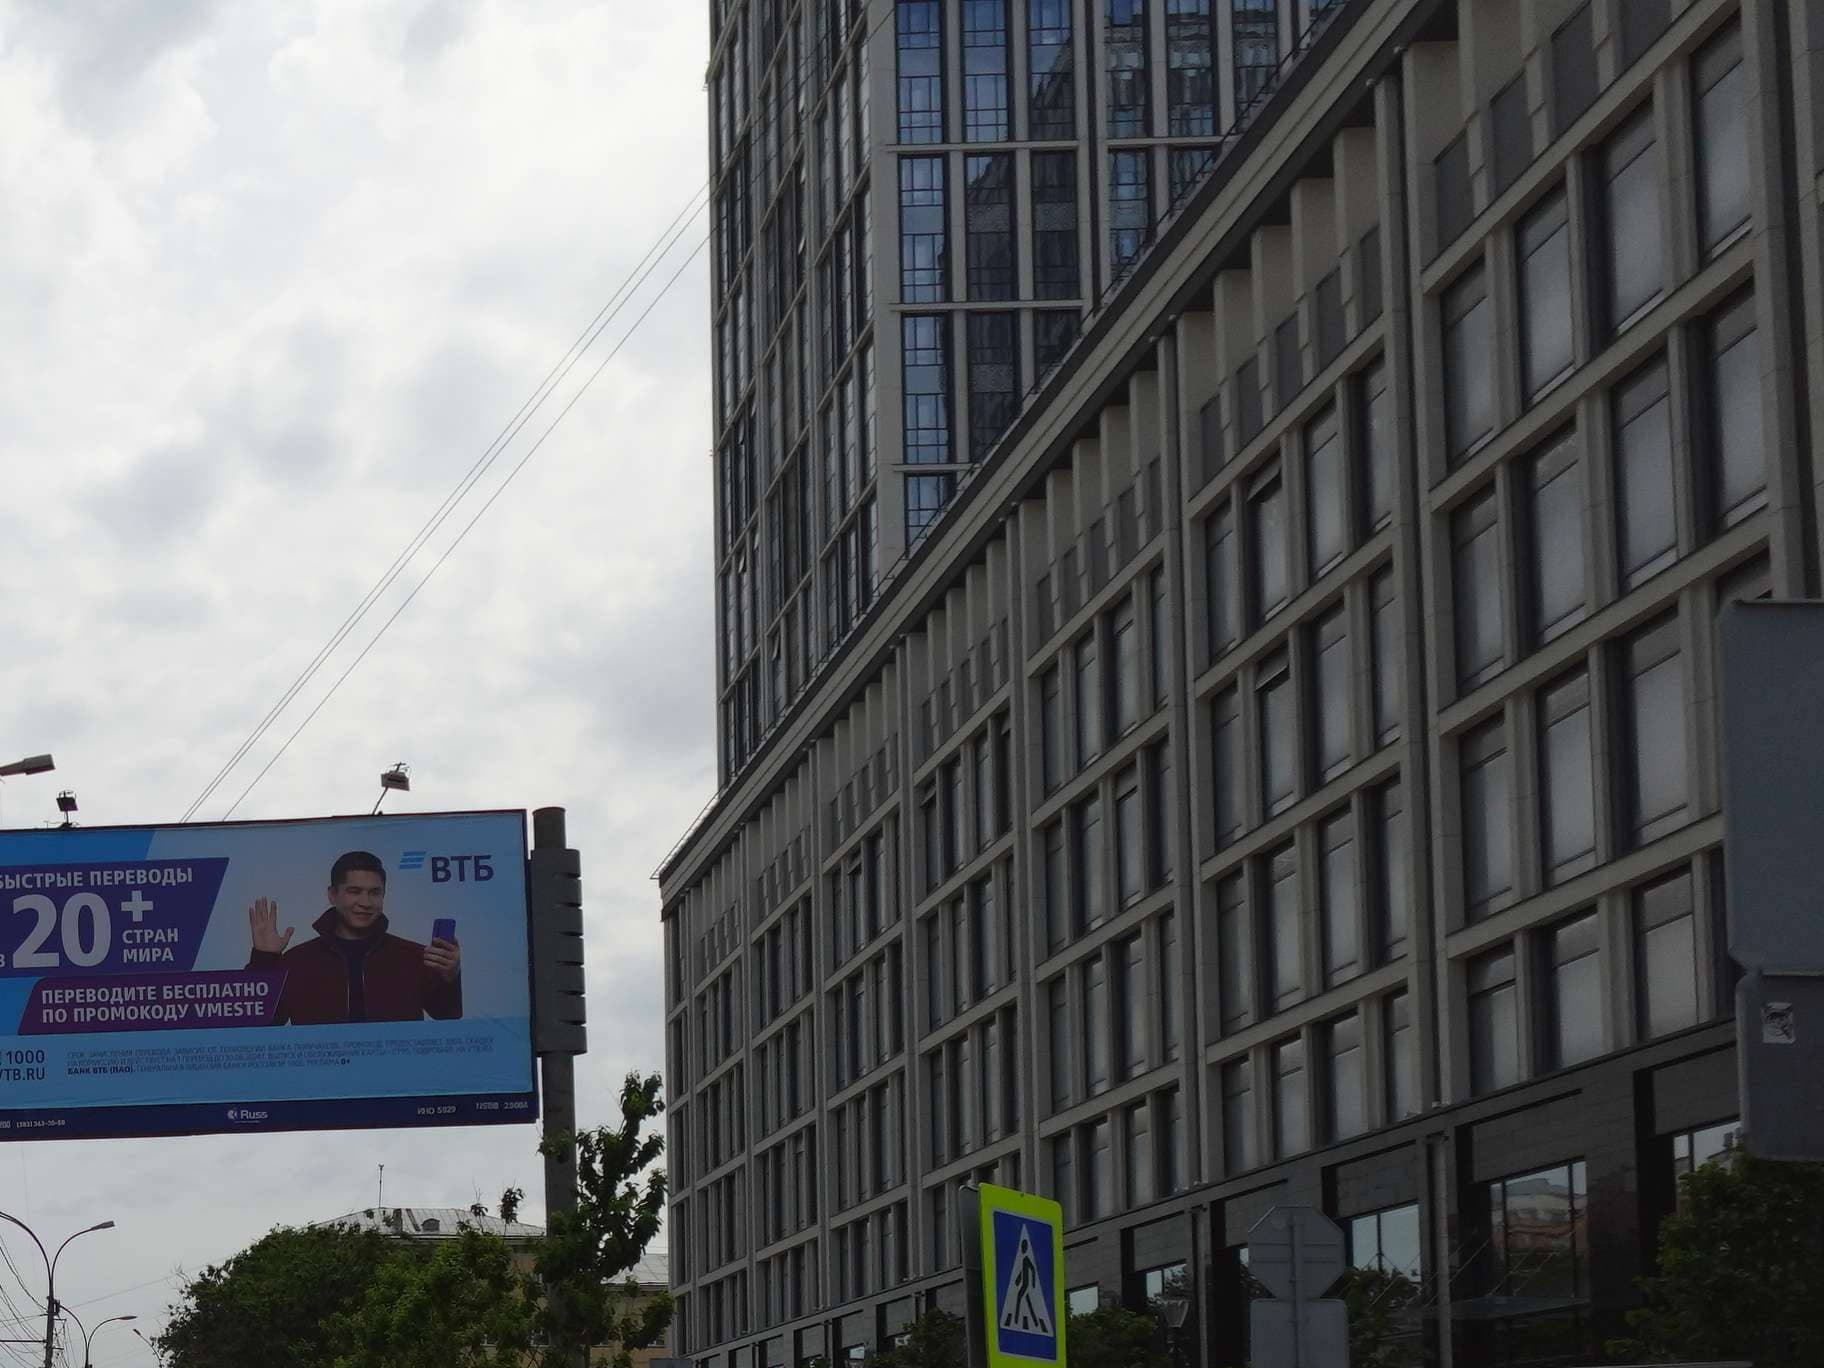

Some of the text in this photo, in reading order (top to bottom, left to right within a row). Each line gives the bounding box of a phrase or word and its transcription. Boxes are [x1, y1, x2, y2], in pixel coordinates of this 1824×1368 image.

[89, 867, 193, 887] ПЕРЕВОДЫ
[431, 854, 495, 883] ВТБ
[121, 927, 179, 944] СТРАН
[122, 947, 175, 964] МИРА
[41, 981, 269, 1005] ПЕРЕВОДИТЕ БЕСПЛАТНО
[41, 1001, 266, 1024] ПО ПРОМОКОДУ VMESTE
[5, 1049, 46, 1065] 1000
[67, 1066, 91, 1075] БАНК
[92, 1066, 108, 1075] ВТБ
[240, 1109, 269, 1120] Russ
